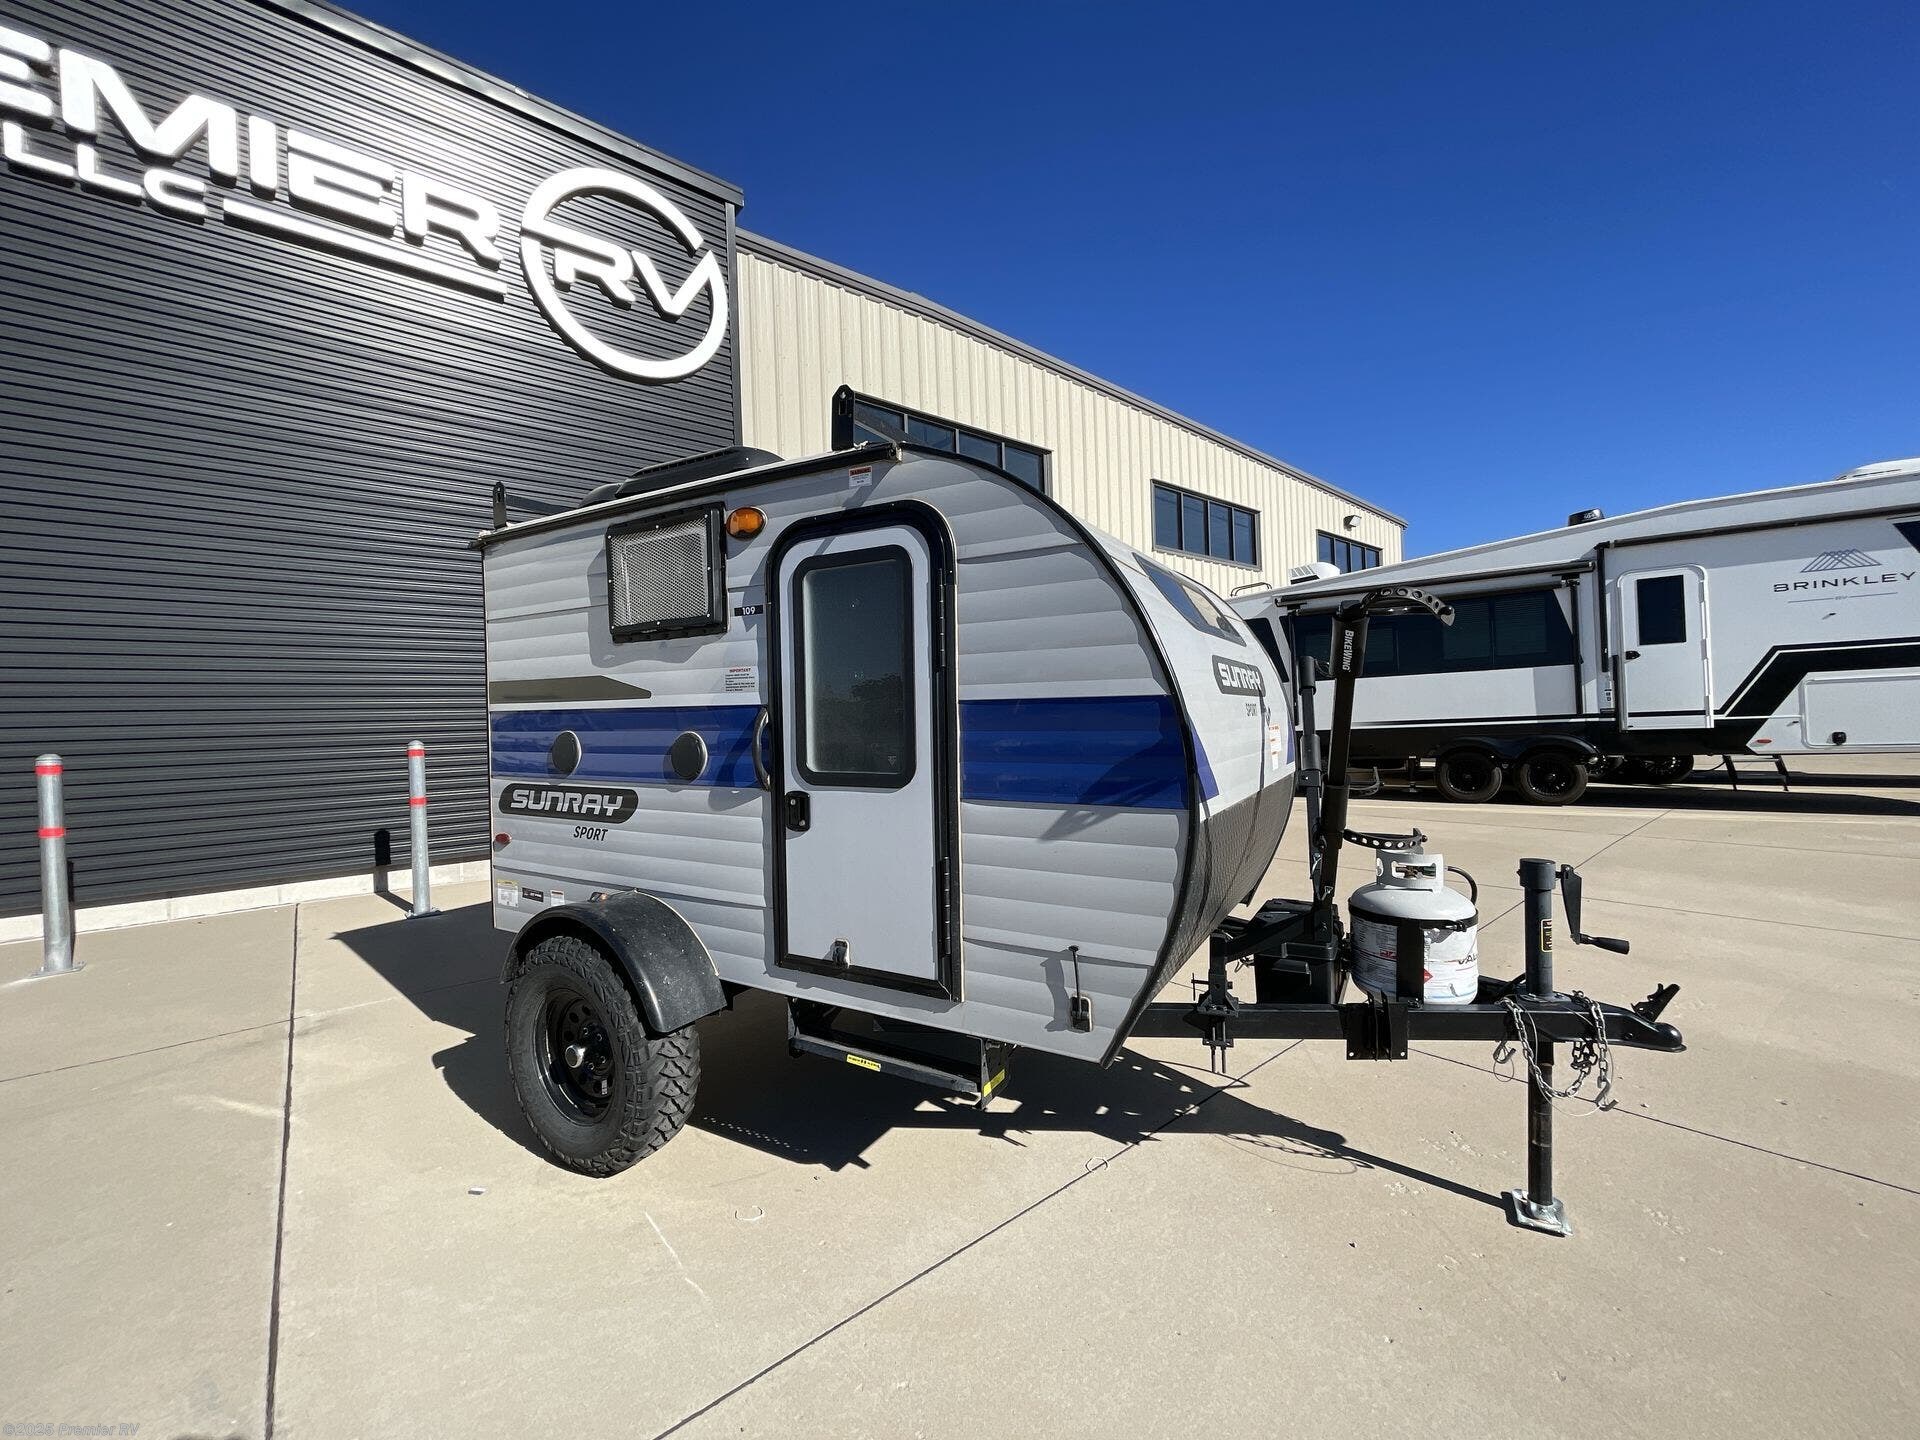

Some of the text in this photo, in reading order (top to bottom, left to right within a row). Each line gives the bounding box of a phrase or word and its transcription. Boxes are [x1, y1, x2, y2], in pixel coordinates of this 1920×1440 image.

[3, 121, 207, 214] LLC
[543, 221, 714, 315] RV
[1773, 571, 1916, 592] BRINKLEY
[742, 606, 756, 615] 109
[1342, 630, 1354, 671] BIKEWING
[1218, 662, 1261, 690] SUNRAY
[510, 789, 623, 816] SUNRAY
[574, 826, 608, 841] SPORT
